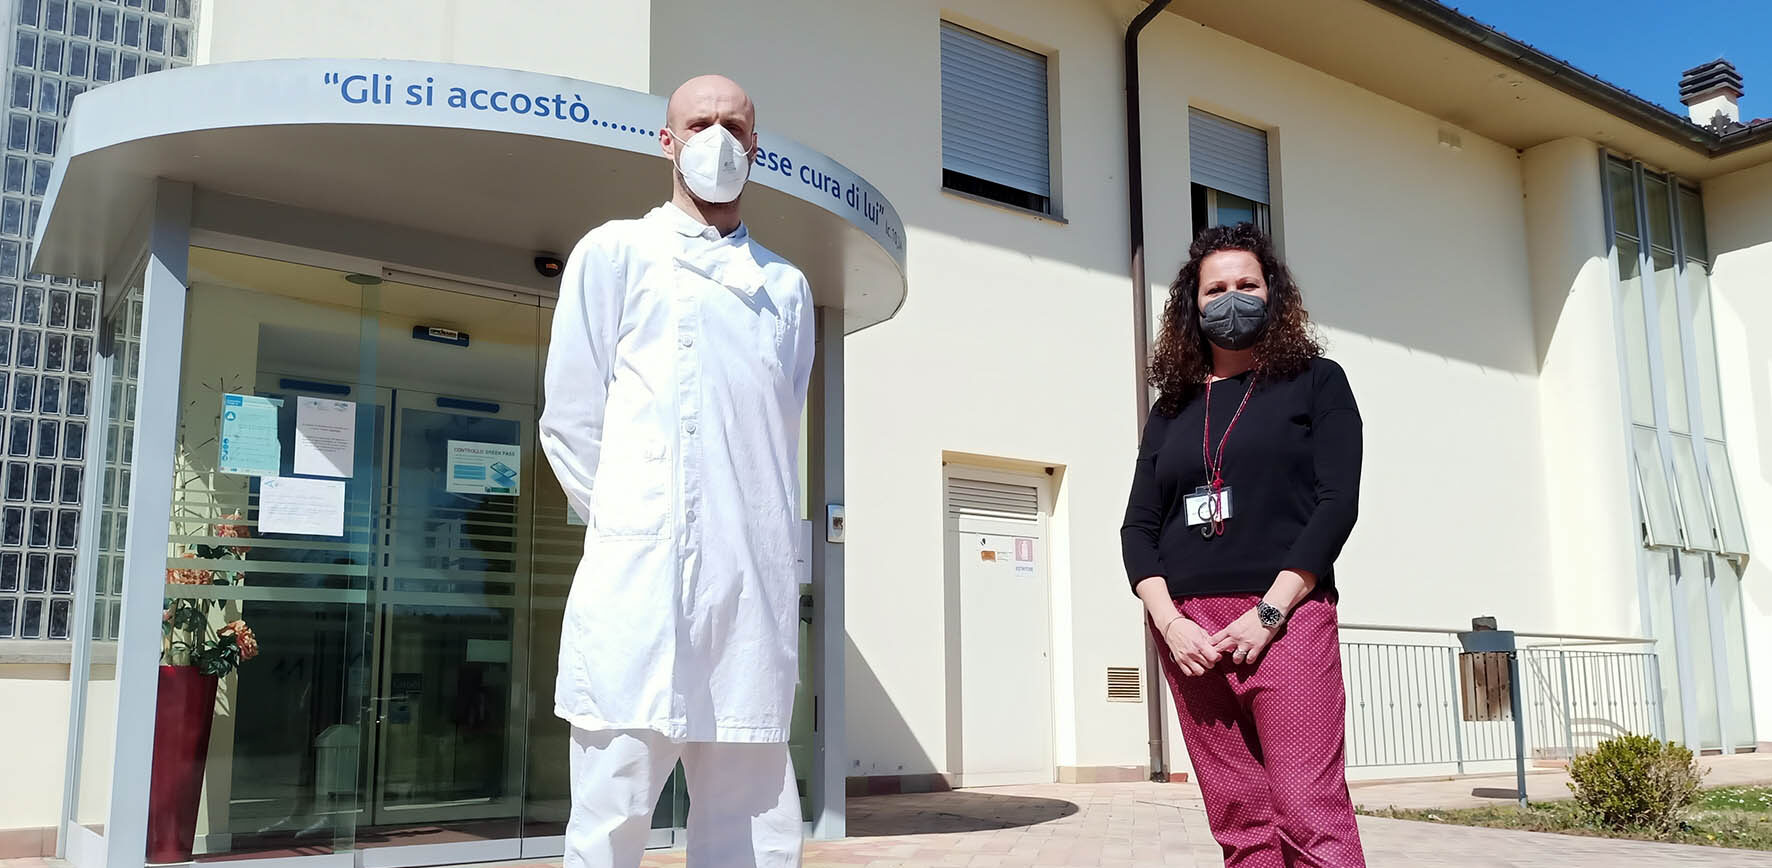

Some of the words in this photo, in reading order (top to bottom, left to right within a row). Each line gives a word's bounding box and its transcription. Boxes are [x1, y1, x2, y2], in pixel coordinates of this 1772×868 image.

[405, 77, 434, 106] si
[755, 146, 792, 177] ese
[800, 165, 841, 200] cura
[846, 183, 859, 211] di
